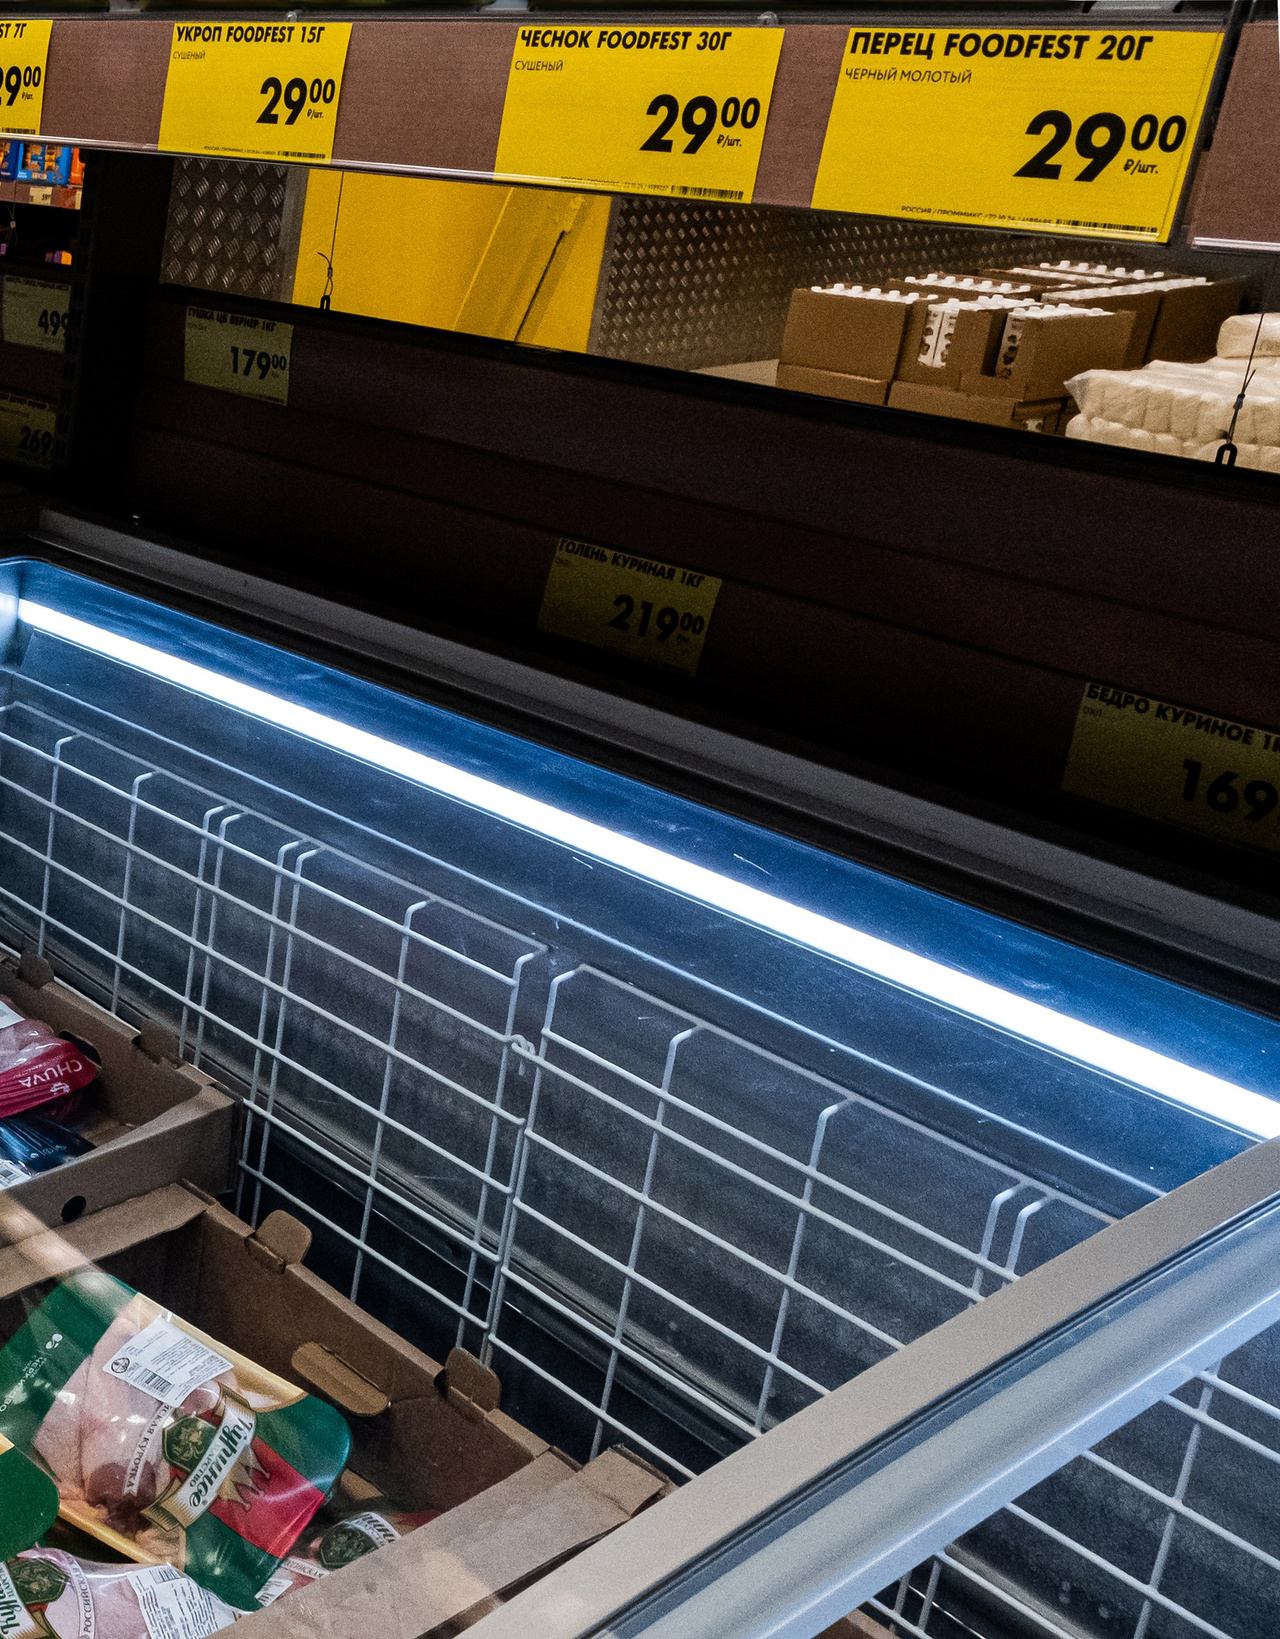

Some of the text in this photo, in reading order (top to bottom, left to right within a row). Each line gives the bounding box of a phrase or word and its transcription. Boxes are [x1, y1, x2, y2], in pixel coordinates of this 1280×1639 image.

[13, 23, 27, 38] 7Г
[176, 26, 326, 44] УКРОП FOODFEST 15Г
[521, 30, 732, 50] ЧЕСНОК FOODFEST 30Г
[850, 32, 1154, 62] ПЕРЕЦ FOODFEST 20Г
[514, 59, 564, 72] СУШЕНЫЙ
[844, 66, 972, 84] ЧЕРНЫЙ МОЛОТЫЙ
[256, 76, 336, 126] 29 00
[639, 94, 761, 154] 29 00
[1013, 110, 1187, 183] 29 00
[188, 307, 214, 321] ТУШКА
[216, 311, 228, 326] ЦБ
[230, 314, 260, 330] ВЕРНЕР
[230, 346, 270, 380] 179
[18, 426, 52, 456] 269
[559, 538, 706, 590] ГОЛЕНЬ КУРИНАЯ 1КГ
[608, 594, 680, 644] 219
[1086, 684, 1150, 715] БЕДРО
[1154, 703, 1255, 746] КУРИНОЕ
[1182, 758, 1279, 824] 169
[19, 1060, 83, 1088] CHUVA
[126, 1437, 150, 1488] КУРОЧКА
